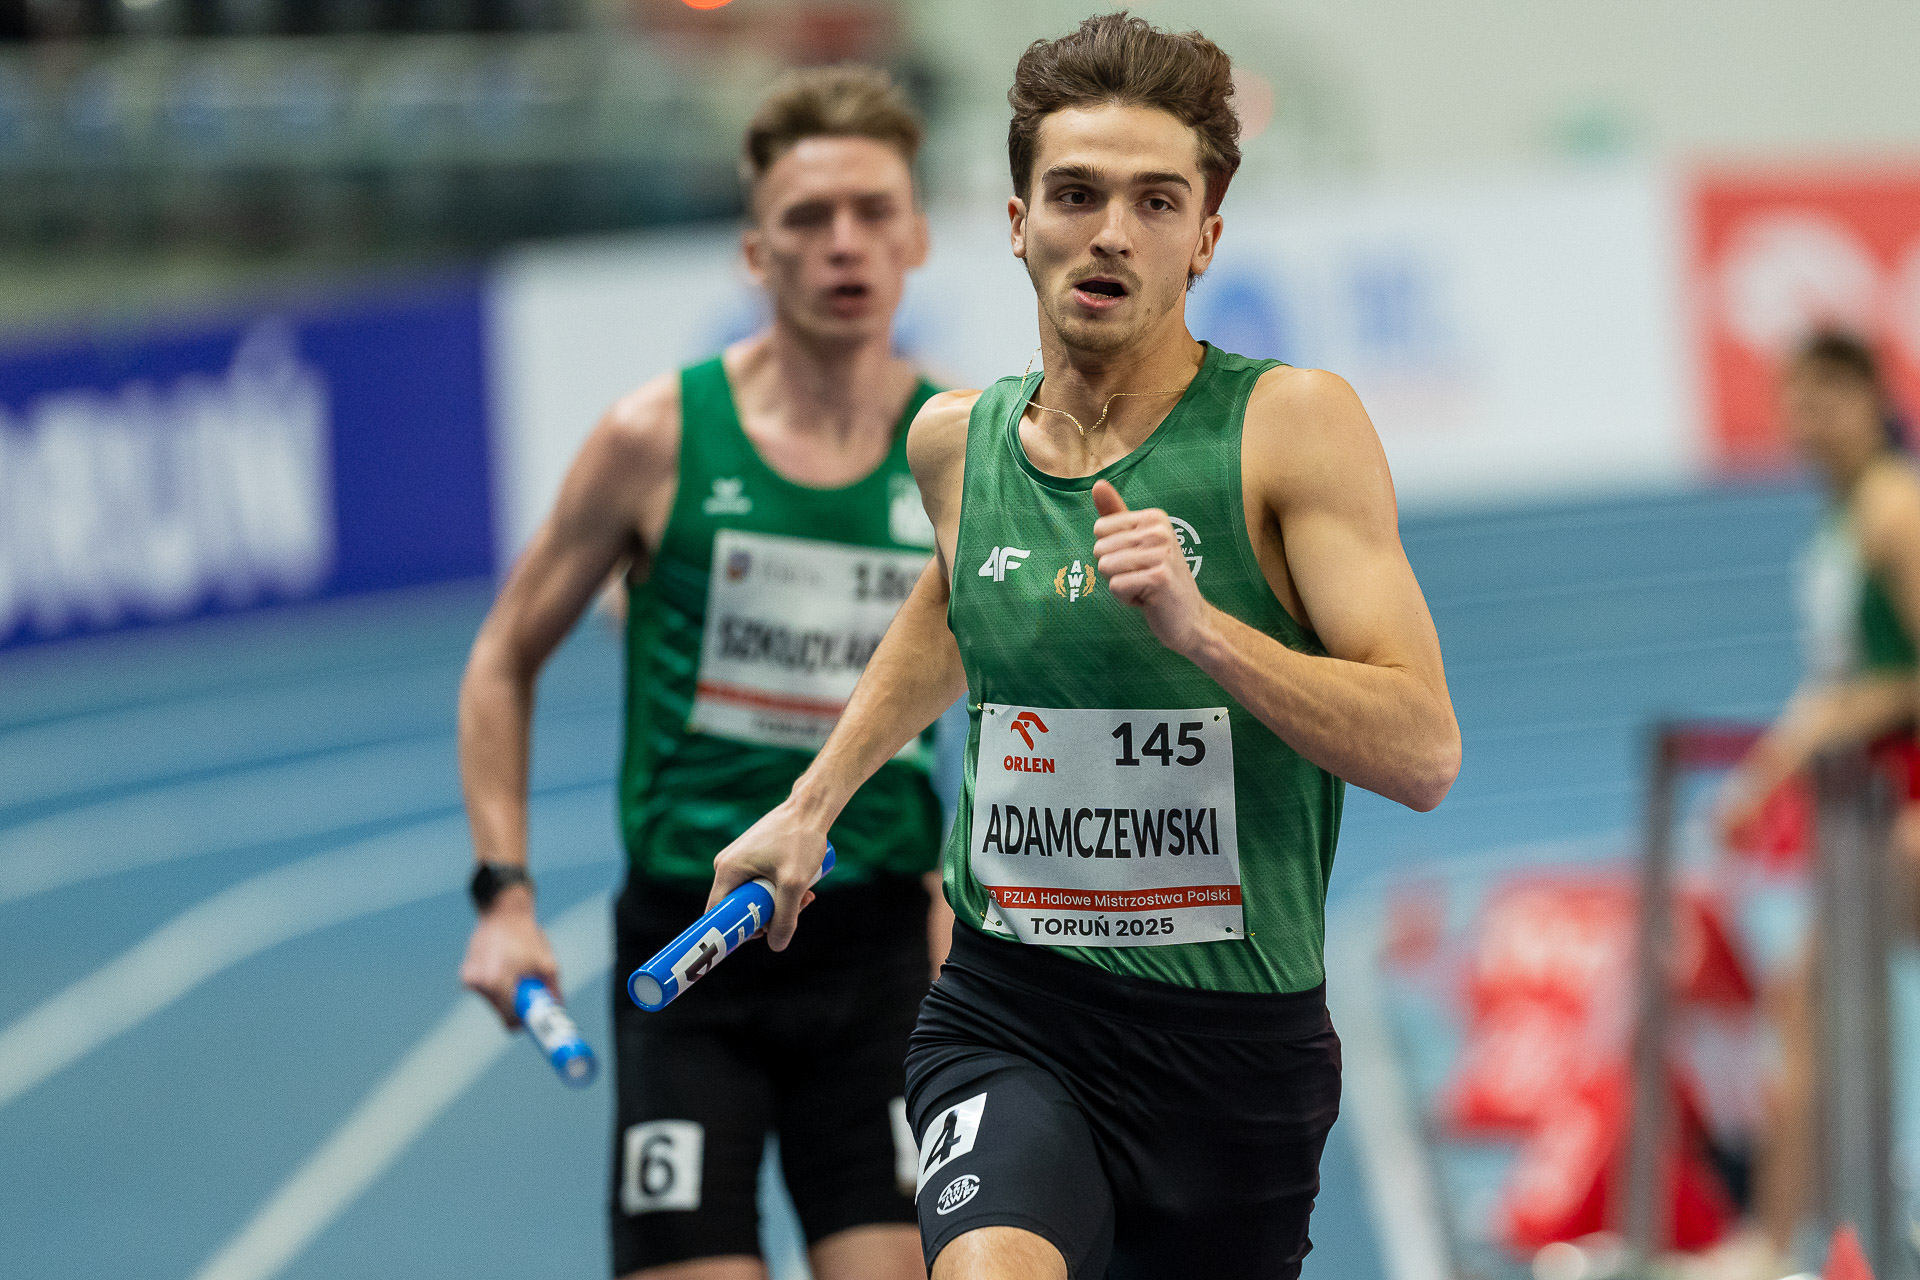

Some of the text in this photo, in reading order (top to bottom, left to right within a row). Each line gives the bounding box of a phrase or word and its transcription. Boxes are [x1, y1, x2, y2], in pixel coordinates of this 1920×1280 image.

[978, 545, 1031, 583] 4F
[1003, 755, 1056, 774] ORLEN
[1111, 721, 1206, 767] 145
[982, 803, 1220, 859] ADAMCZEWSKI
[1003, 891, 1037, 904] PZLA
[1040, 892, 1092, 906] Halowe
[1094, 892, 1183, 907] Mistrzostwa
[1187, 888, 1231, 902] Polski
[1030, 914, 1175, 937] TORUŃ 2025
[923, 1109, 962, 1175] 4
[639, 1133, 677, 1198] 6
